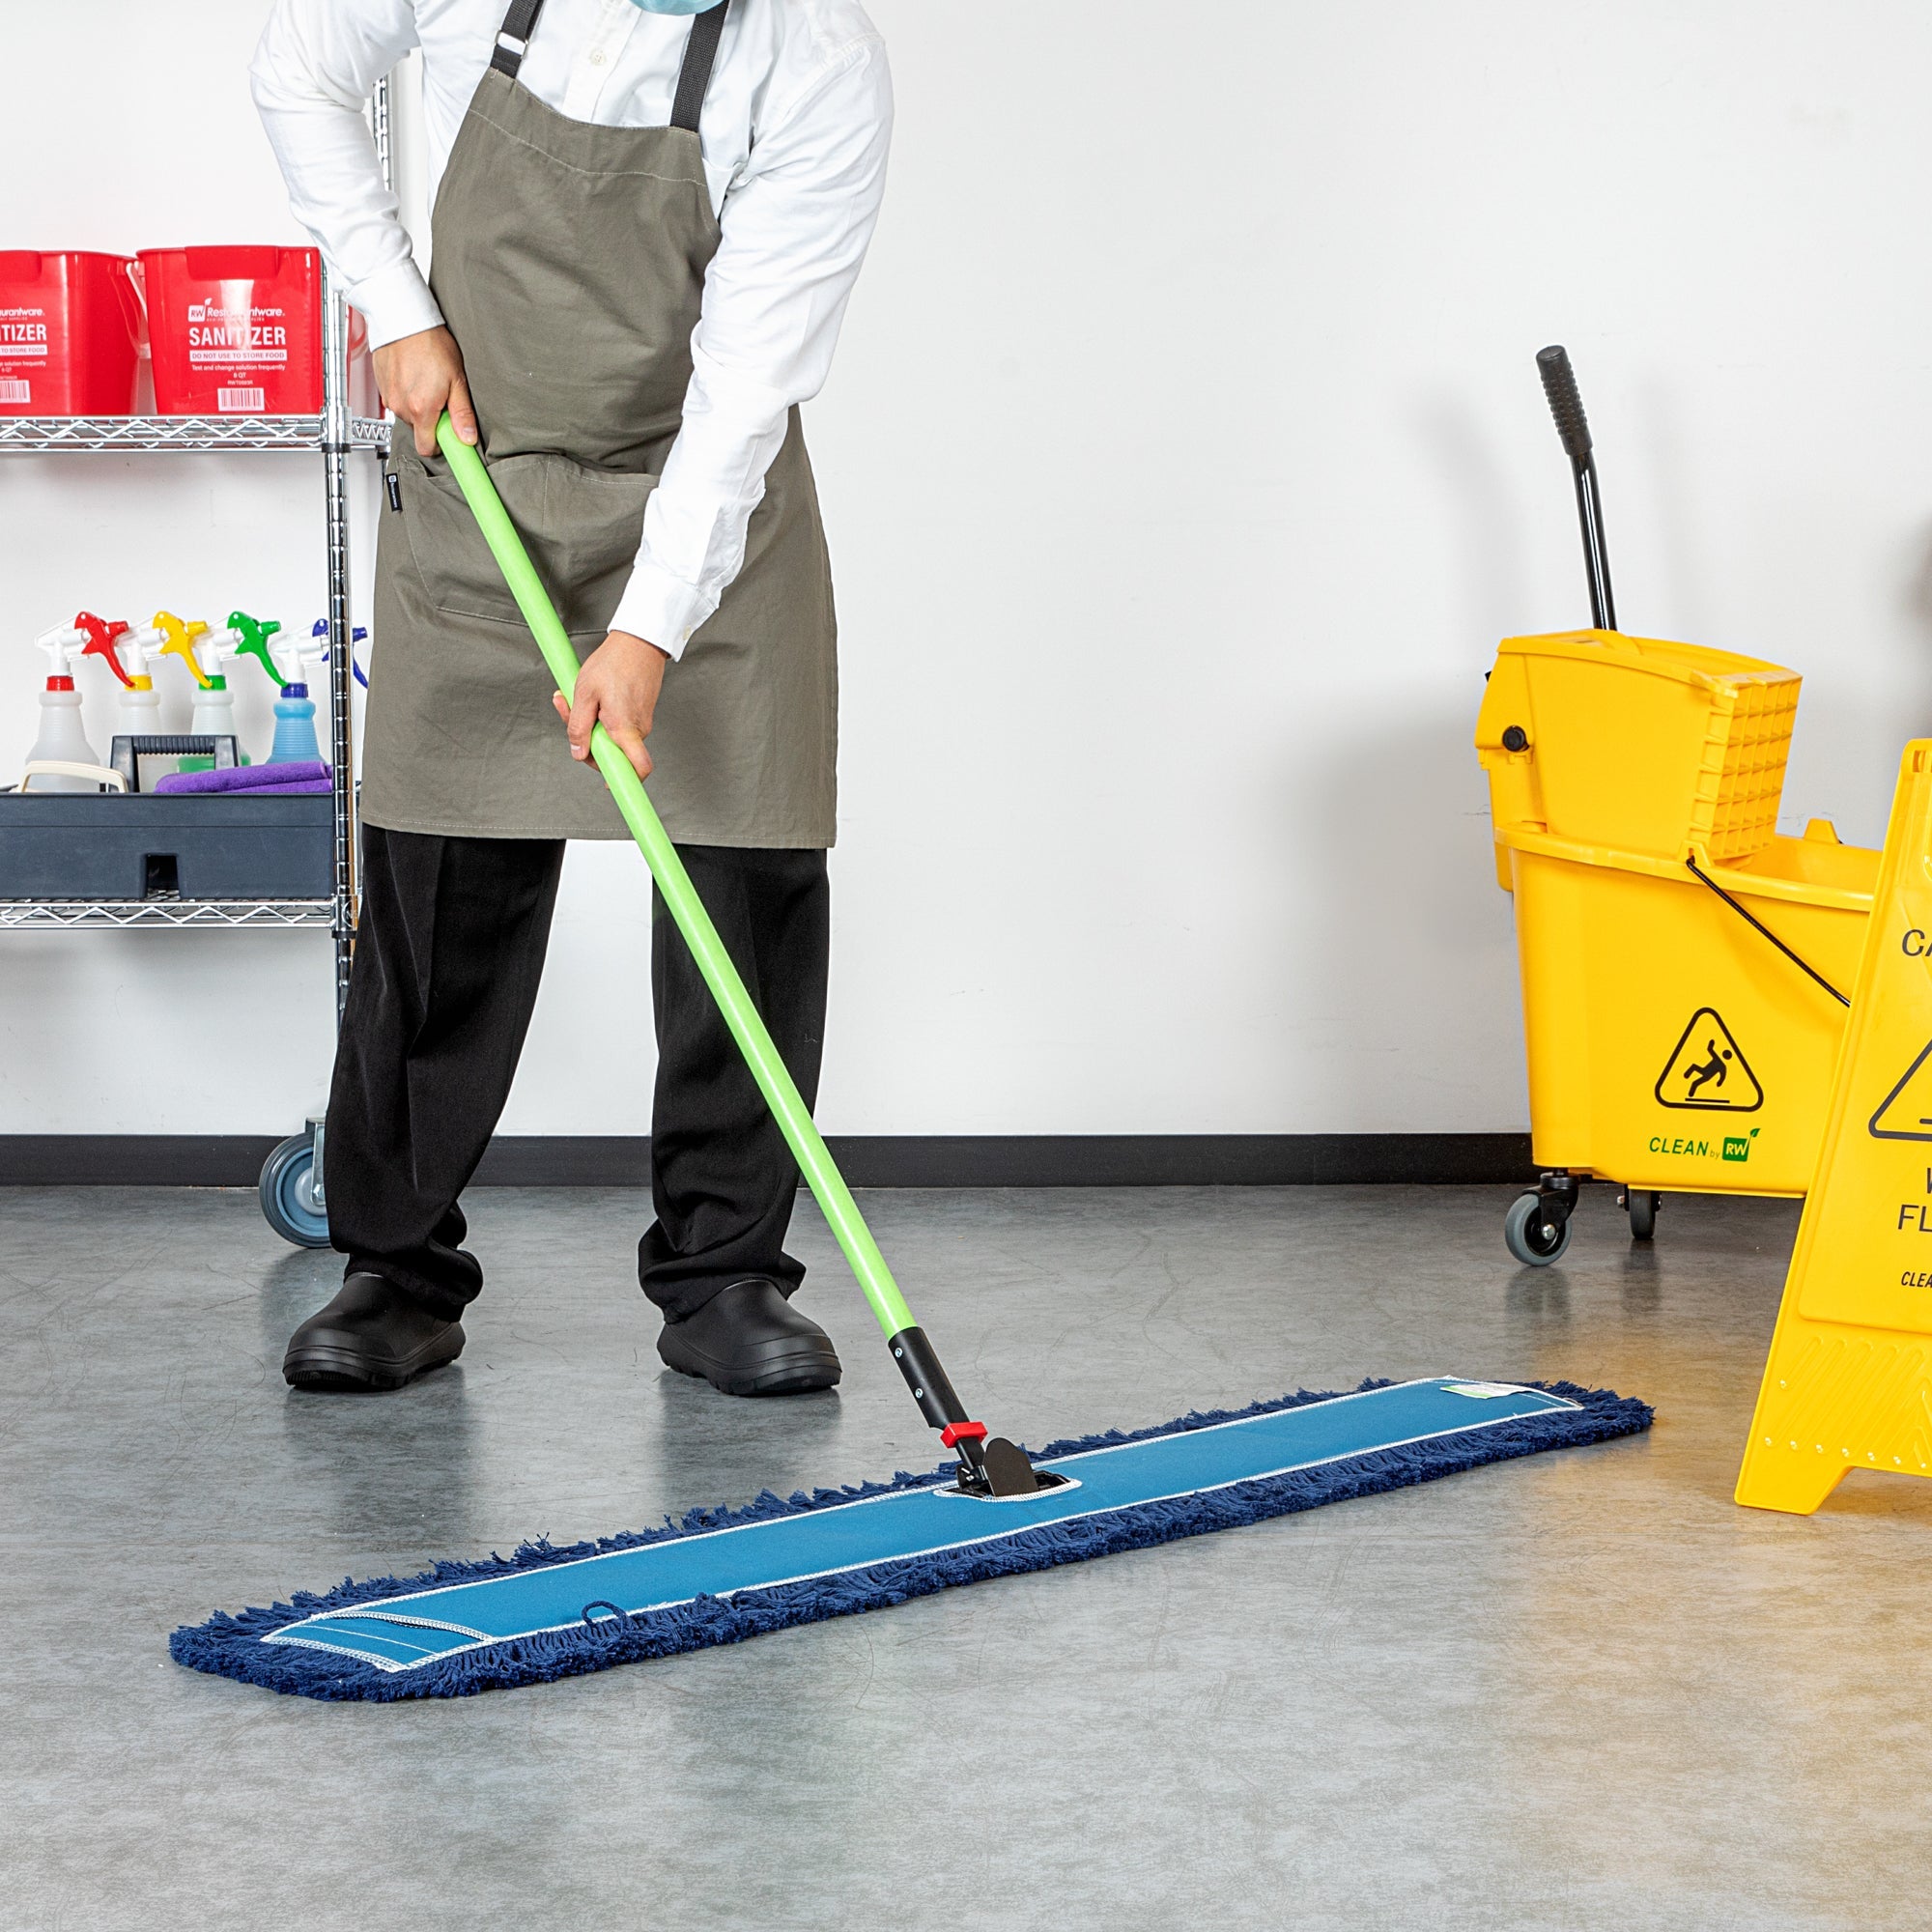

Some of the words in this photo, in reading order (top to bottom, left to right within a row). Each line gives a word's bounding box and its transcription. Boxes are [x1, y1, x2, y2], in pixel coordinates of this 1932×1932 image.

[190, 309, 205, 318] RW
[189, 327, 286, 346] SANITIZER
[1902, 928, 1932, 956] C
[1649, 1137, 1709, 1156] CLEAN
[1710, 1151, 1720, 1160] by
[1725, 1143, 1747, 1156] RW
